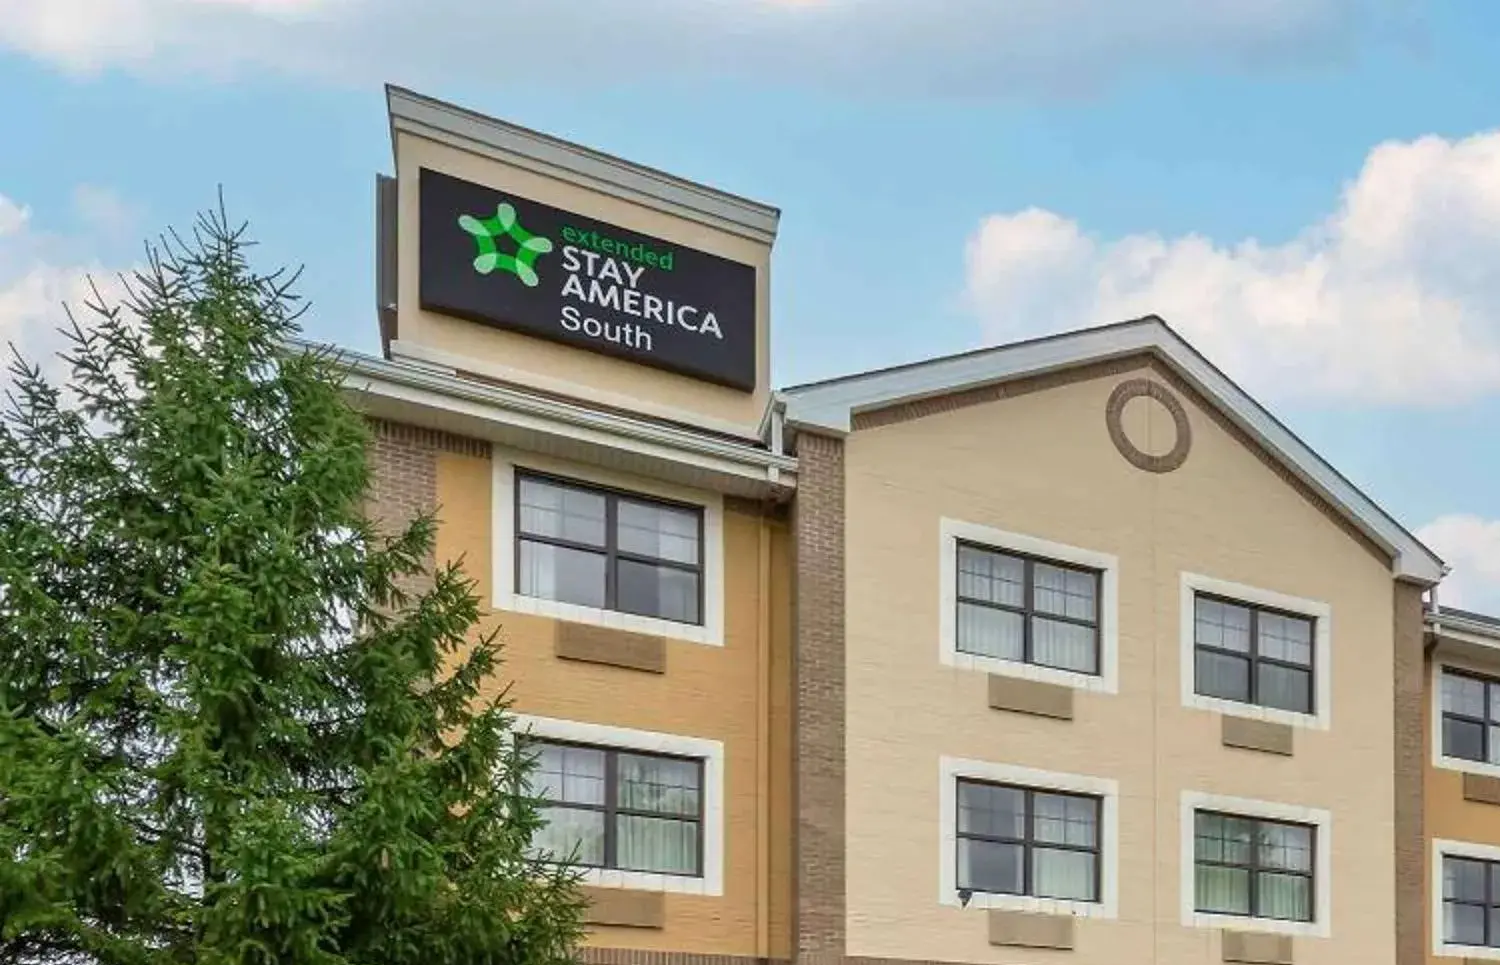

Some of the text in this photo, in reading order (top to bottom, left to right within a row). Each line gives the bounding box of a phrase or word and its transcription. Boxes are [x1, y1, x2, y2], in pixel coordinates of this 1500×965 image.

[562, 225, 673, 271] extended
[562, 245, 645, 289] STAY
[561, 274, 723, 339] AMERICA
[561, 306, 652, 351] South
